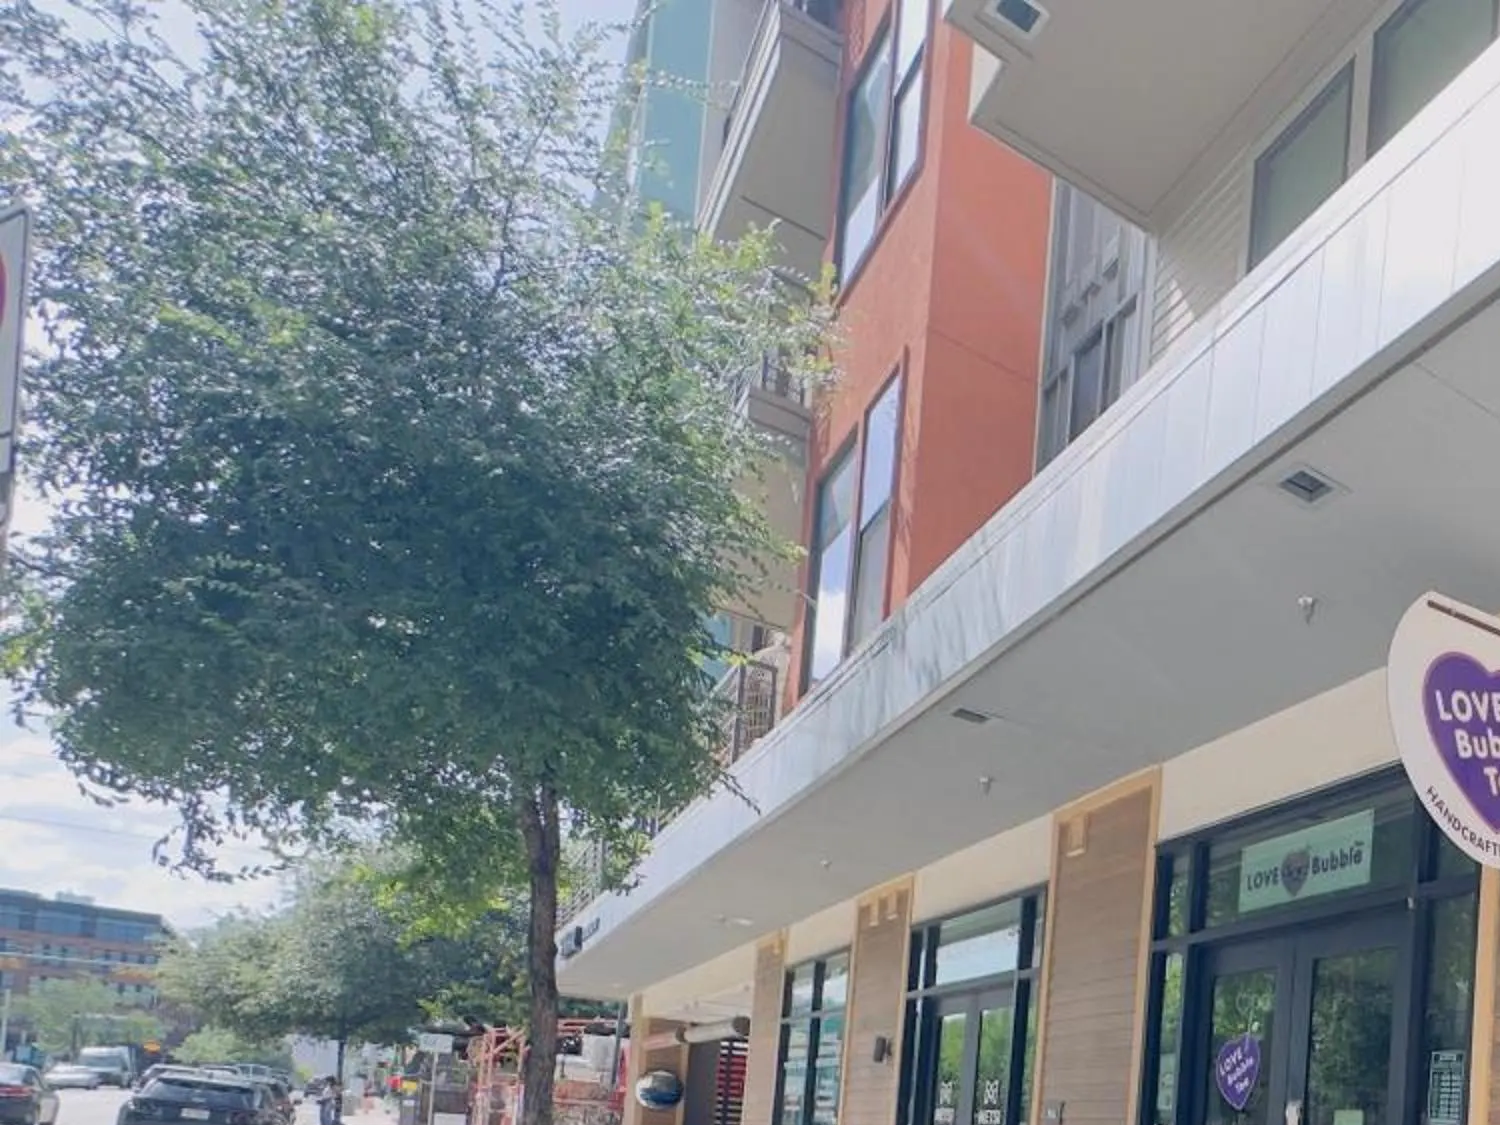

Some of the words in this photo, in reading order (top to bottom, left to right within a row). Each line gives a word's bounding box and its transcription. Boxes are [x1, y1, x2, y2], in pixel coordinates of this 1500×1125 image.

[1247, 866, 1278, 891] LOVE
[1311, 847, 1362, 875] Bubble
[1221, 1046, 1242, 1076] LOVE
